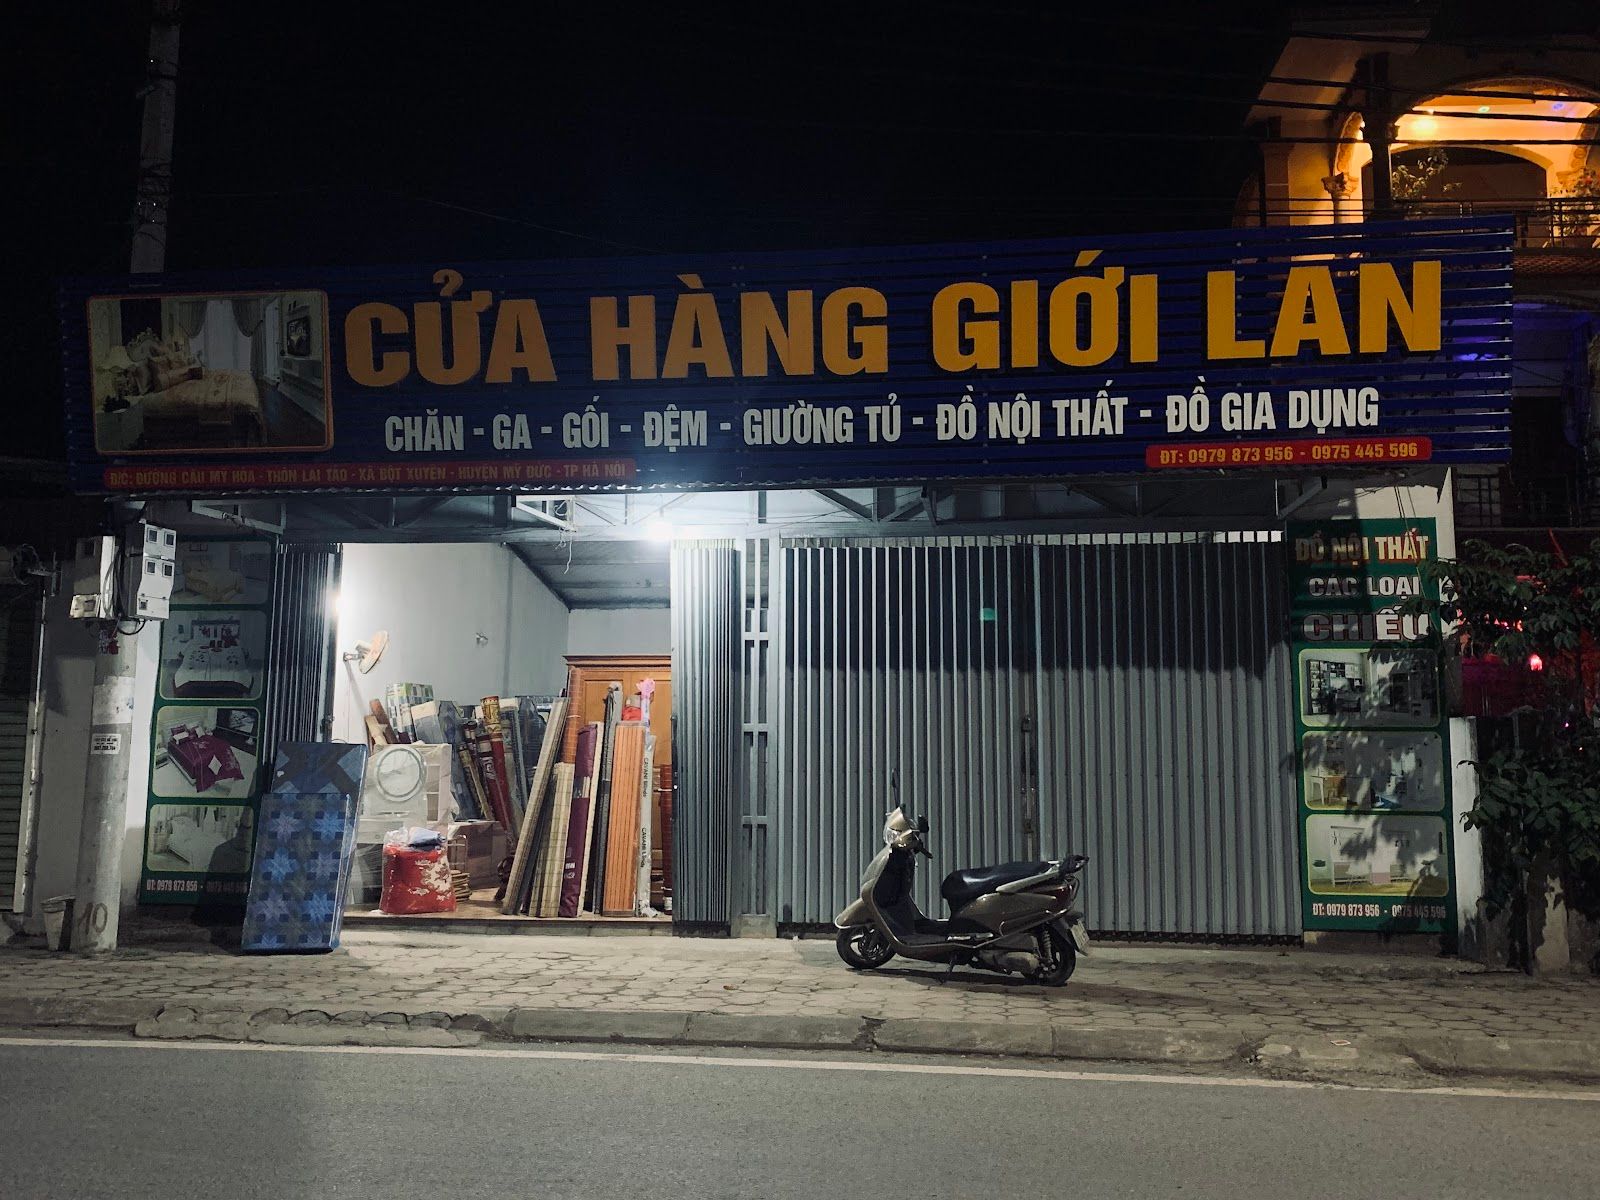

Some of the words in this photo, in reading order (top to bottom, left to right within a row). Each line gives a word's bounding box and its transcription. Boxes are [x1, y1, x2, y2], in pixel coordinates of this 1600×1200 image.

[344, 269, 557, 387] CỬA
[590, 273, 889, 382] HÀNG
[932, 250, 1158, 372] GIỚI
[1207, 260, 1442, 360] LAN
[385, 408, 464, 451] CHĂN
[492, 414, 533, 450] GA
[562, 395, 609, 448] GỐI
[643, 404, 707, 453] ĐỆM
[743, 400, 853, 445] GIƯỜNG
[864, 392, 901, 443] TỦ
[936, 385, 977, 441] ĐỒ
[988, 393, 1041, 444] NỘI
[1052, 379, 1128, 437] THẤT
[1165, 376, 1209, 433] ĐỒ
[1221, 392, 1276, 431] GIA
[1288, 387, 1379, 434] DỤNG
[1160, 449, 1183, 465] ĐT:
[1188, 448, 1226, 463] 0979
[1232, 447, 1260, 462] 873
[1264, 446, 1293, 461] 956
[1312, 444, 1350, 460] 0975
[1355, 443, 1384, 458] 445
[1389, 442, 1418, 457] 596
[458, 463, 498, 482] HUYỆN
[563, 463, 579, 478] TP
[582, 460, 599, 478] HÀ
[604, 460, 626, 479] NỘI
[1296, 530, 1325, 561] ĐỒ
[1331, 533, 1370, 566] NỘI
[1375, 528, 1429, 560] THẤT
[1309, 574, 1357, 596] CÁC
[1366, 576, 1420, 600] LOẠI
[1303, 605, 1430, 641] CHIẾU
[173, 880, 185, 892] 873
[1312, 903, 1325, 916] ĐT:
[1326, 903, 1346, 916] 0979
[1348, 904, 1363, 917] 873
[1365, 904, 1380, 917] 956
